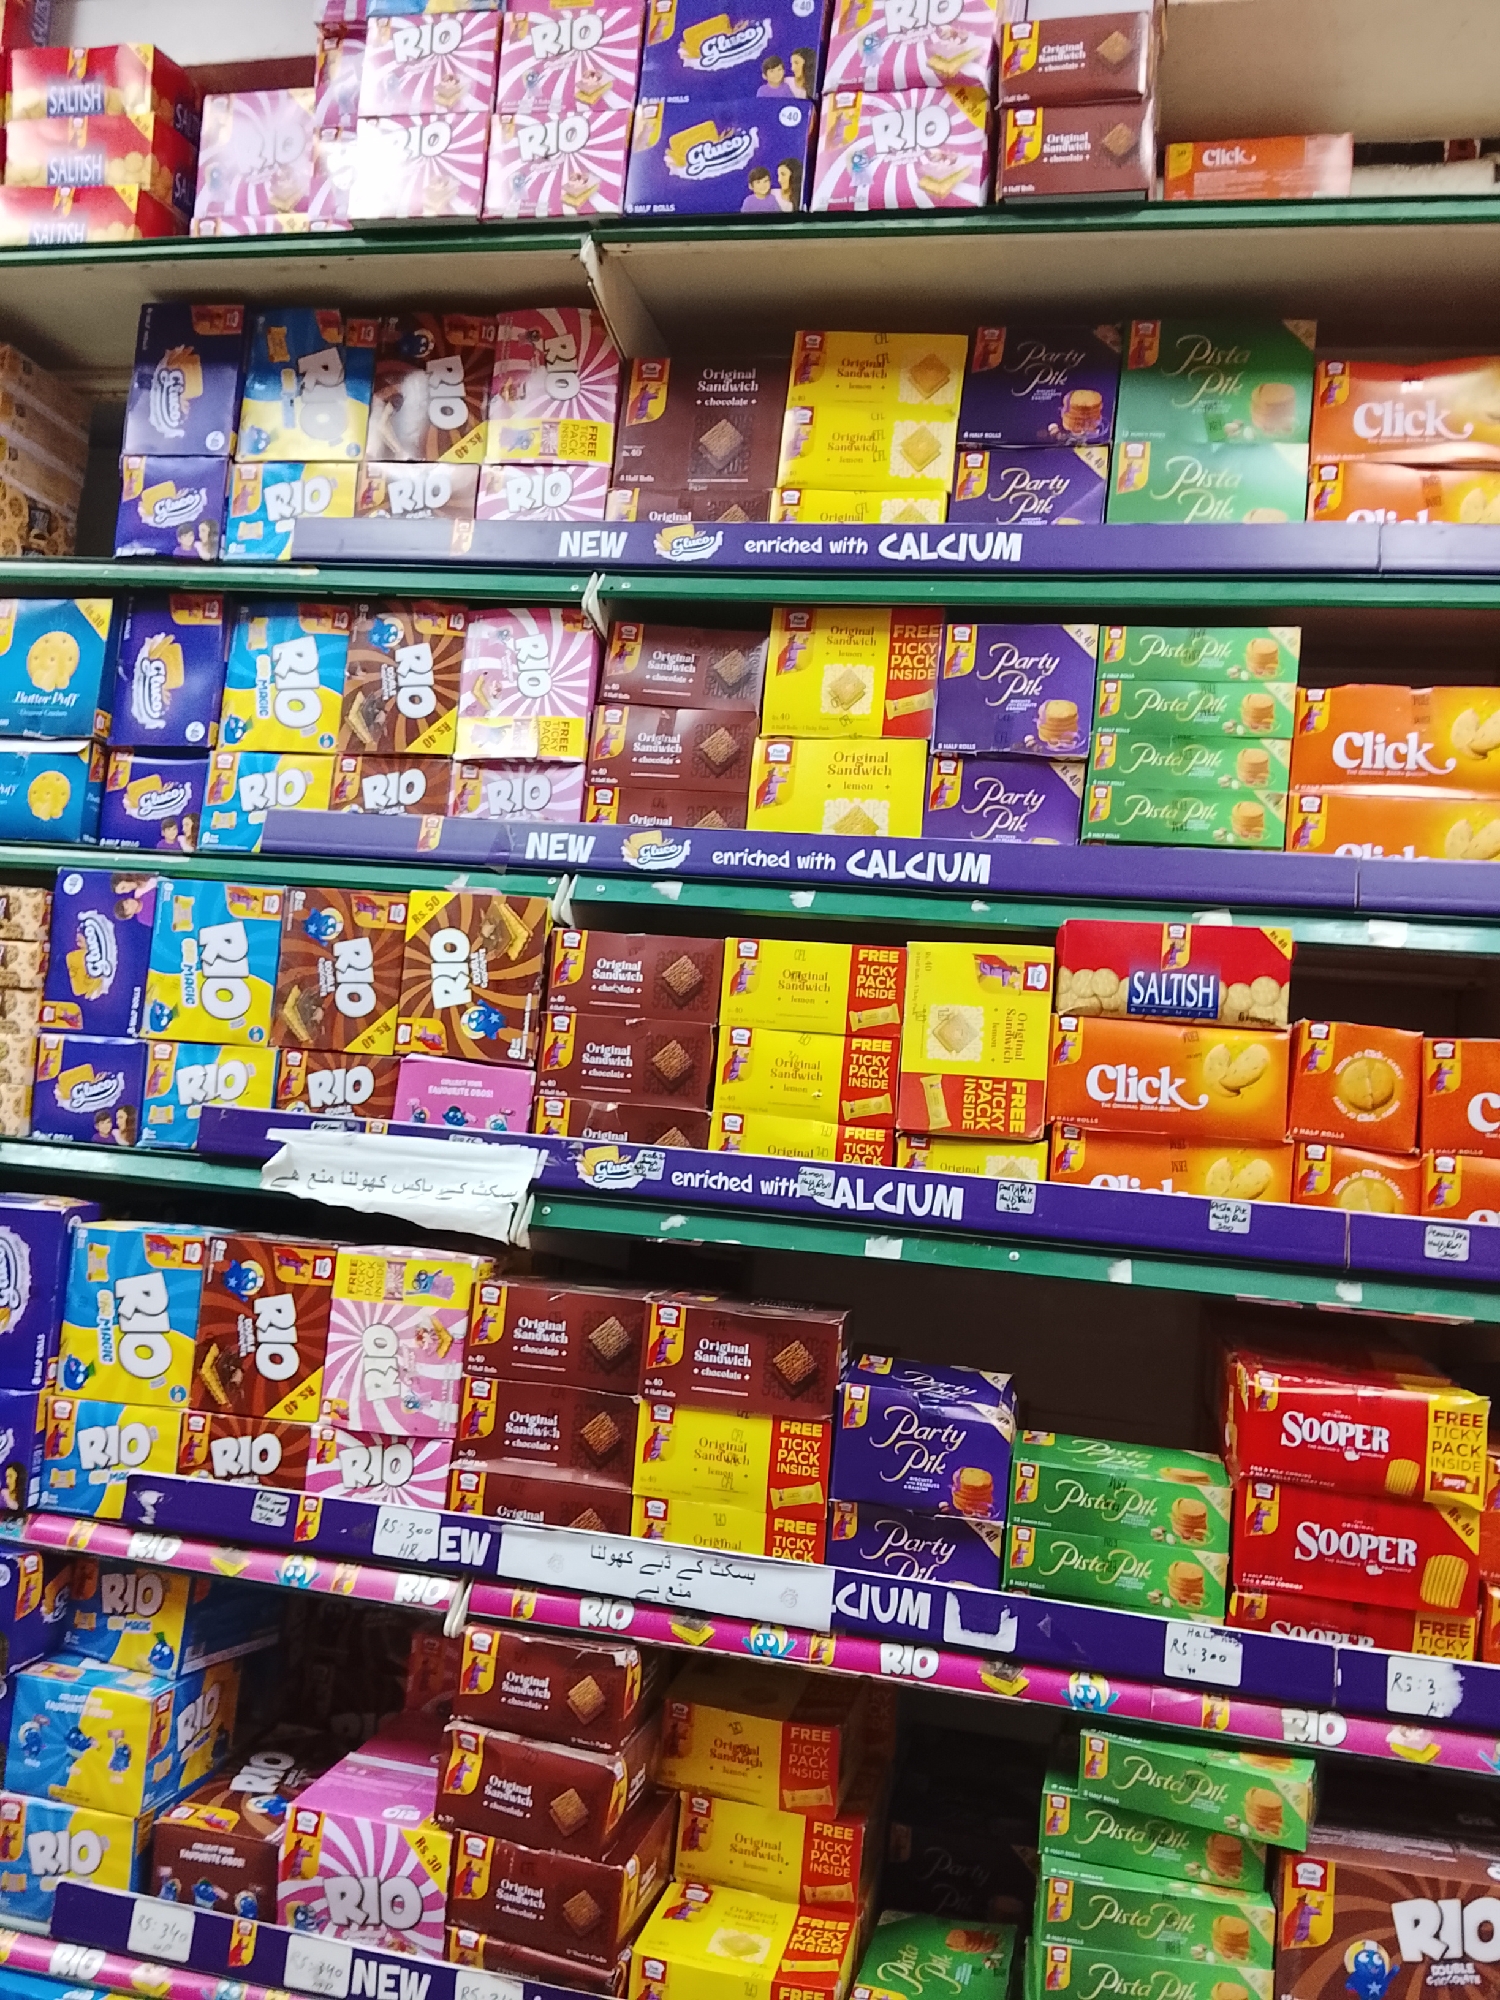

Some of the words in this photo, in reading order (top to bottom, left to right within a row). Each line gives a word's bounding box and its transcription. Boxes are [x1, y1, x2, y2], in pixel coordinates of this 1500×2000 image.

[532, 15, 603, 59] RIO
[48, 84, 102, 114] SALTISH
[518, 117, 589, 160] RIO
[871, 105, 950, 154] RIO
[1043, 142, 1091, 153] Sandwich
[1202, 147, 1256, 167] Click
[49, 152, 102, 184] SALTISH
[654, 204, 676, 212] ROLLS
[1004, 341, 1086, 371] Party
[1162, 334, 1251, 376] Pista
[703, 369, 756, 380] Original
[1011, 363, 1068, 396] Pik
[426, 355, 468, 430] RIO
[1353, 400, 1473, 440] Click
[988, 467, 1070, 502] Party
[1150, 456, 1242, 500] Pista
[388, 471, 452, 516] RIO
[558, 530, 628, 559] NEW
[671, 534, 718, 556] Gluco
[744, 537, 823, 554] enriched
[830, 538, 869, 555] with
[878, 532, 1023, 562] CALCIUM
[893, 625, 940, 639] FREE
[891, 642, 938, 655] TICKY
[891, 655, 937, 668] PACK
[976, 642, 1059, 681] Party
[271, 635, 322, 728] RIO
[652, 674, 685, 684] chocolate
[889, 669, 937, 681] INSIDE
[984, 670, 1042, 707] Pik
[13, 690, 46, 705] Butter
[51, 692, 80, 708] Puff
[258, 679, 269, 717] MAGIC
[1332, 731, 1457, 775] Click
[843, 781, 873, 791] lemon
[962, 777, 1045, 815] Party
[525, 832, 596, 863] NEW
[638, 842, 686, 865] Gluco
[712, 849, 789, 869] enriched
[796, 851, 836, 871] with
[845, 848, 991, 884] CALCIUM
[422, 893, 440, 911] 50
[199, 920, 251, 1020] RIO
[857, 964, 898, 976] TICKY
[858, 949, 899, 963] FREE
[182, 961, 195, 1006] MAGIC
[333, 937, 377, 1017] RIO
[1132, 971, 1215, 1008] SALTISH
[855, 987, 896, 999] INSIDE
[362, 1034, 377, 1049] 40
[582, 1053, 633, 1067] Sandwich
[589, 1068, 624, 1079] chocolate
[850, 1054, 890, 1066] TICKY
[176, 1060, 249, 1106] RIO
[847, 1077, 889, 1090] INSIDE
[1086, 1063, 1209, 1111] Click
[1009, 1081, 1026, 1133] FREE
[307, 1169, 334, 1189] منع
[670, 1170, 752, 1194] enriched
[760, 1176, 800, 1198] with
[348, 1259, 358, 1295] FREE
[375, 1261, 385, 1298] INSIDE
[115, 1271, 172, 1379] RIO
[254, 1293, 300, 1381] RIO
[513, 1328, 569, 1345] Sandwich
[518, 1316, 567, 1333] Original
[100, 1318, 114, 1363] MAGIC
[698, 1337, 750, 1356] Original
[694, 1350, 752, 1367] Sandwich
[283, 1399, 299, 1416] 40
[780, 1421, 823, 1438] FREE
[869, 1405, 967, 1452] Party
[1281, 1411, 1389, 1454] SOOPER
[1434, 1426, 1483, 1441] TICKY
[77, 1422, 152, 1469] RIO
[211, 1433, 282, 1477] RIO
[779, 1437, 821, 1452] TICKY
[776, 1462, 820, 1478] INSIDE
[879, 1440, 946, 1481] Pik
[1430, 1455, 1481, 1473] INSIDE
[1044, 1479, 1120, 1516] Pista
[406, 1522, 433, 1540] 300
[860, 1520, 956, 1564] Party
[1461, 1522, 1475, 1537] 40
[127, 1532, 182, 1561] RIO
[439, 1526, 491, 1567] EW
[591, 1544, 634, 1568] کھولنا
[1294, 1521, 1417, 1567] SOOPER
[639, 1551, 672, 1576] ڈبے
[676, 1559, 703, 1581] کے
[710, 1559, 756, 1586] بسکٹ
[1038, 1541, 1109, 1577] Pista
[101, 1573, 164, 1616] RIO
[394, 1576, 451, 1605] RIO
[665, 1583, 692, 1602] منع
[580, 1597, 634, 1630] RIO
[832, 1582, 931, 1629] CIUM
[124, 1620, 151, 1632] MAGIC
[1418, 1621, 1471, 1638] FREE
[1200, 1648, 1227, 1663] 300
[1418, 1637, 1470, 1651] TICKY
[880, 1643, 939, 1679] RIO
[505, 1670, 550, 1687] Original
[790, 1726, 831, 1743] FREE
[1281, 1709, 1347, 1747] RIO
[788, 1754, 829, 1769] PACK
[790, 1743, 830, 1756] TICKY
[787, 1766, 830, 1781] INSIDE
[1113, 1755, 1185, 1791] Pista
[812, 1821, 855, 1841] FREE
[1074, 1809, 1146, 1844] Pista
[28, 1830, 104, 1876] RIO
[810, 1850, 851, 1868] PACK
[812, 1839, 852, 1855] TICKY
[427, 1854, 443, 1875] 30
[808, 1862, 851, 1878] INSIDE
[323, 1874, 423, 1931] RIO
[495, 1888, 546, 1910] Sandwich
[500, 1879, 545, 1898] Original
[1077, 1894, 1152, 1931] Pista
[791, 1936, 843, 1947] PACK
[1392, 1897, 1500, 1963] RIO
[49, 1942, 106, 1980] RIO
[1430, 1962, 1475, 1976] DOUBLE
[351, 1957, 432, 2000] NEW
[1426, 1973, 1482, 1986] CHOCOLATE
